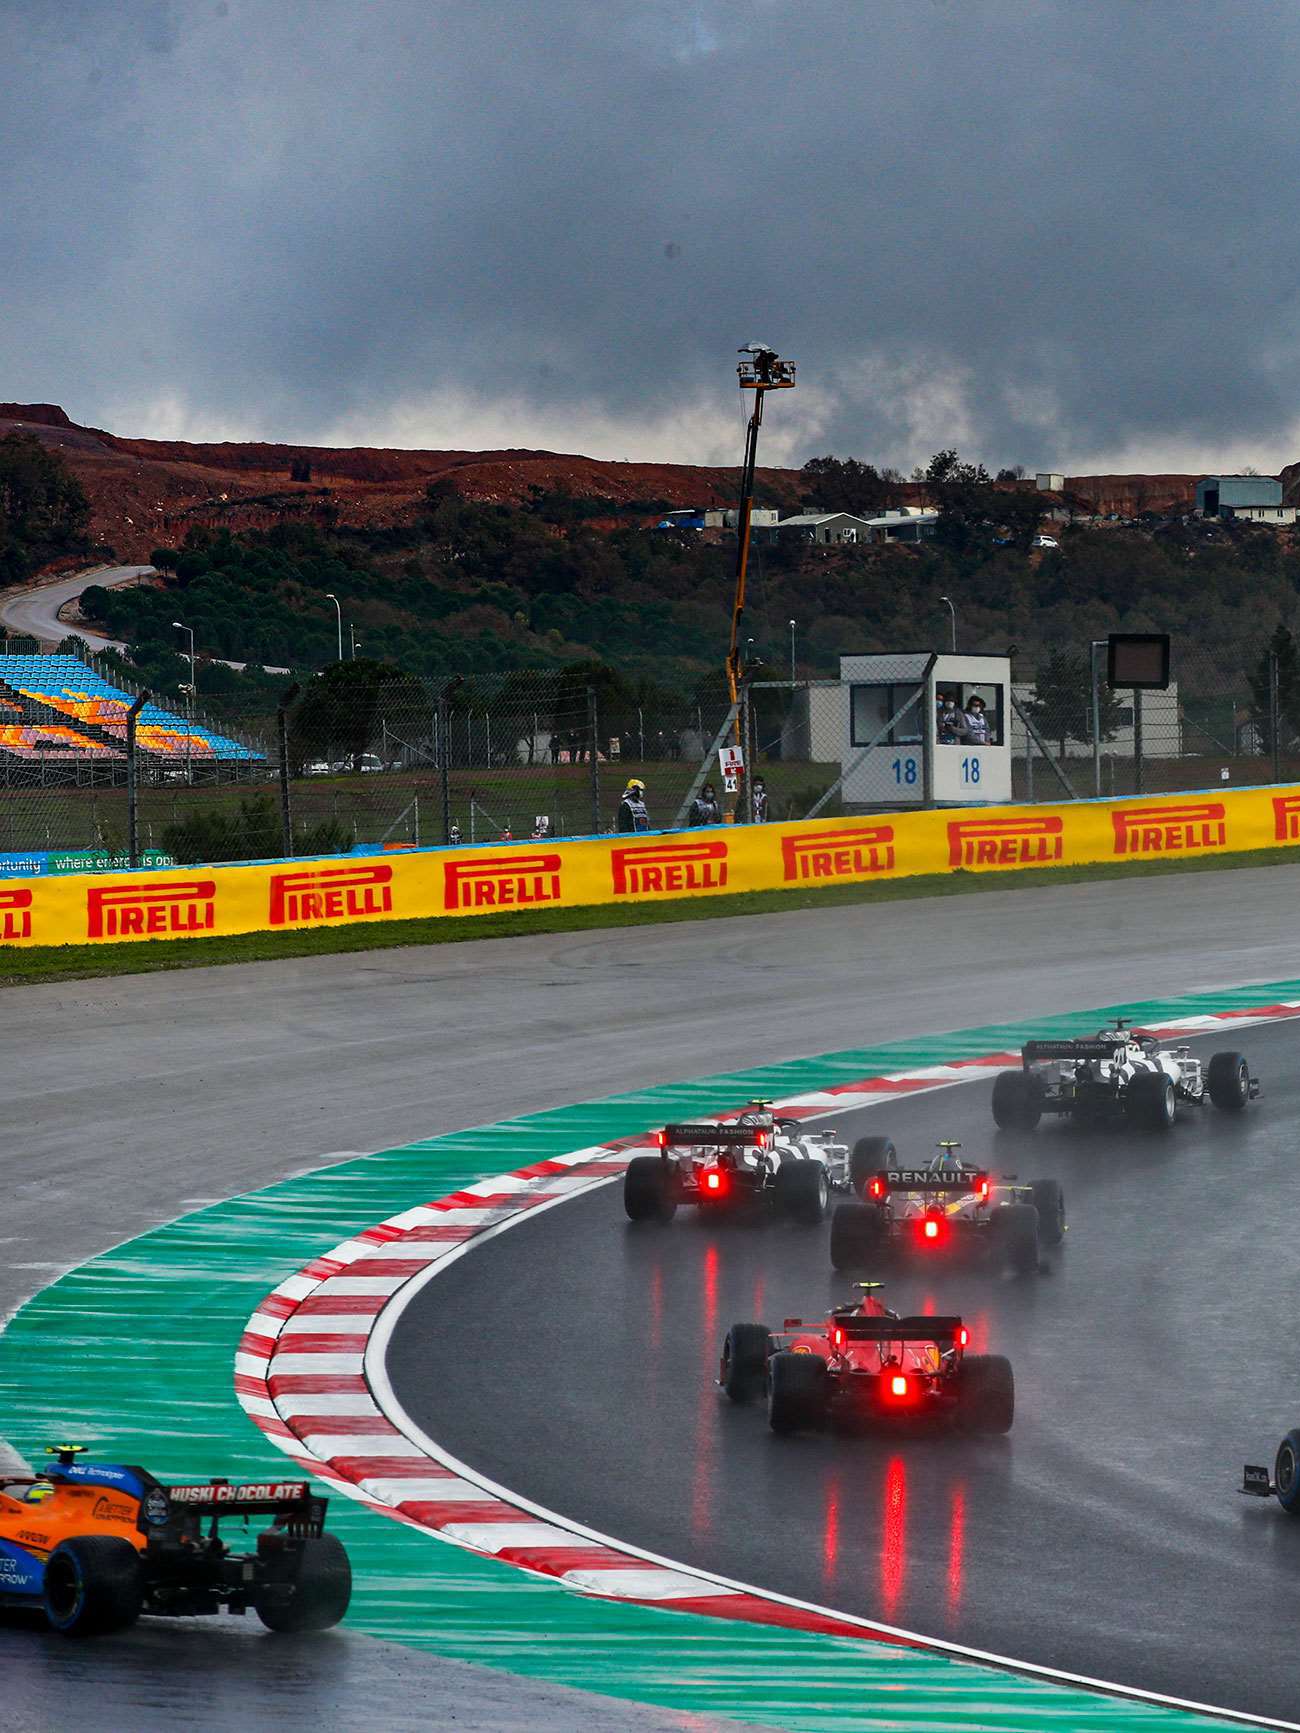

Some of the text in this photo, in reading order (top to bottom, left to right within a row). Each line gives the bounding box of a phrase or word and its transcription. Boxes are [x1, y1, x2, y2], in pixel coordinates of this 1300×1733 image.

[892, 759, 916, 784] 18
[962, 758, 980, 783] 18
[947, 816, 1063, 866] PIRELLI
[1112, 803, 1225, 854] PIRELLI
[0, 857, 41, 874] rtunity
[55, 856, 93, 869] where
[142, 855, 152, 867] is
[611, 841, 728, 894] PIRELLI
[781, 825, 895, 881] PIRELLI
[269, 865, 393, 925] PIRELLI
[444, 854, 561, 910] PIRELLI
[87, 881, 216, 938] PIRELLI
[719, 1128, 754, 1136] FASHION
[888, 1171, 977, 1185] RENAULT
[170, 1485, 303, 1501] HUSKI CHOCOLATE
